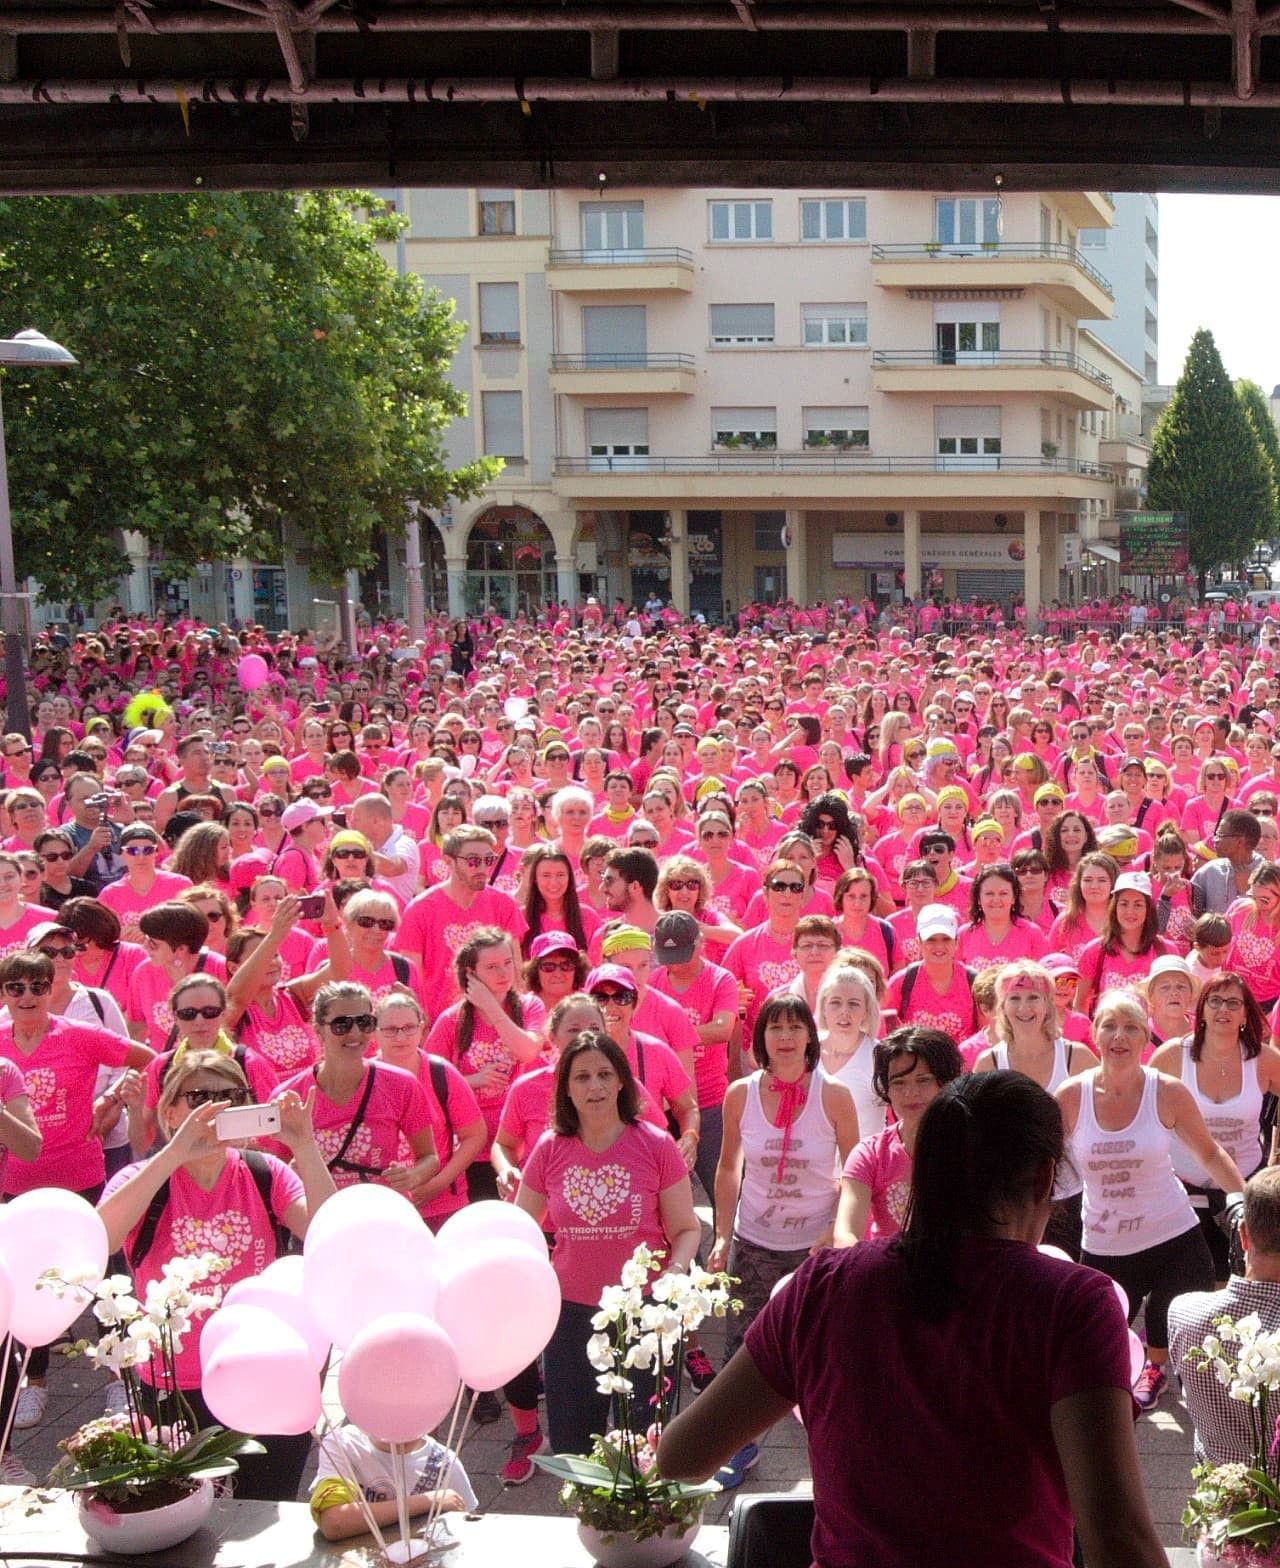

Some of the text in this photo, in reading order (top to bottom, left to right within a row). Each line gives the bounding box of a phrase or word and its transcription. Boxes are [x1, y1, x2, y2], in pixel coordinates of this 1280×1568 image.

[761, 1157, 809, 1169] SPRT
[631, 1194, 642, 1225] 2018
[1117, 1216, 1146, 1235] FIT
